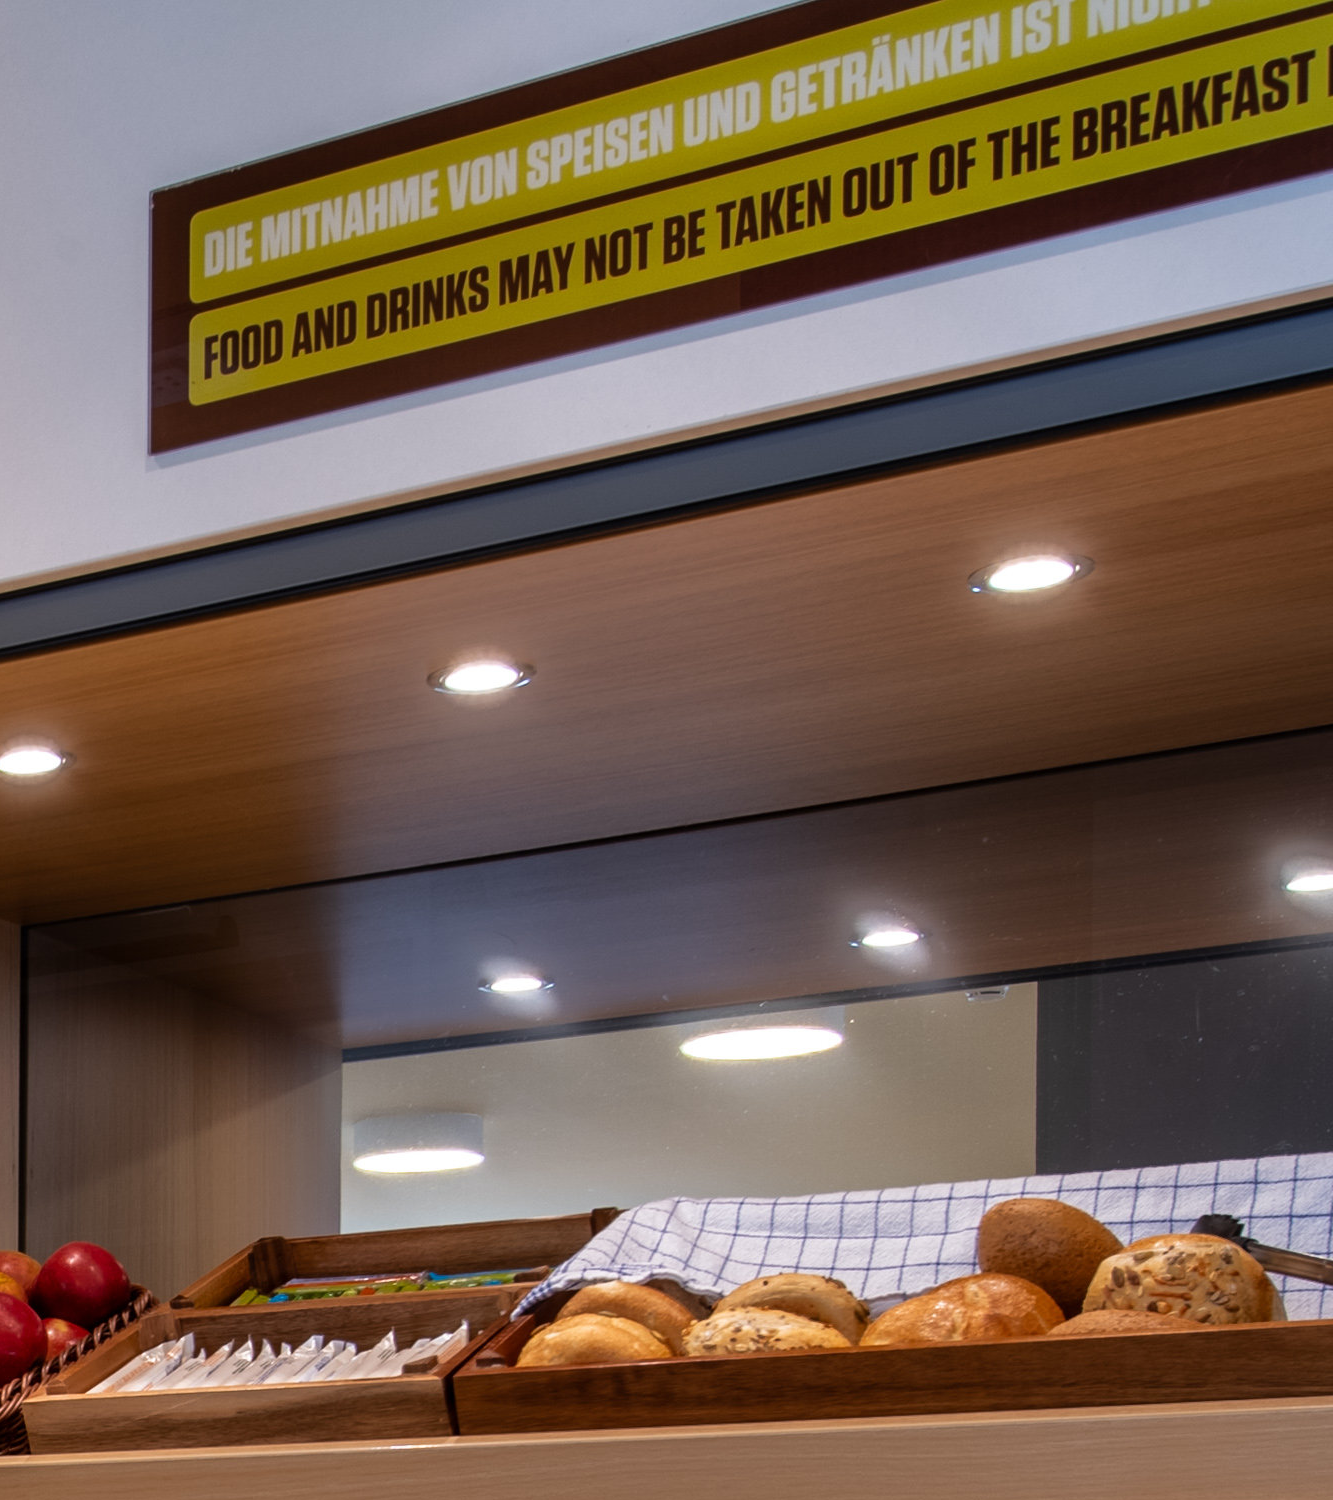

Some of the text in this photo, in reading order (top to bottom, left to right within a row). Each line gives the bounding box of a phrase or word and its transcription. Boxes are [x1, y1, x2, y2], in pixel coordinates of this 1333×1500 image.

[204, 221, 253, 278] DIE
[260, 170, 439, 262] MITNAHME
[446, 147, 518, 212] VON
[526, 103, 674, 190] SPEISEN
[683, 80, 761, 147] UND
[770, 13, 1001, 123] GETRÄNKEN
[1010, 0, 1075, 59] IST
[204, 318, 284, 380] FOOD
[291, 300, 357, 358] AND
[366, 265, 490, 339] DRINKS
[498, 241, 575, 306] MAY
[584, 222, 653, 284] NOT
[663, 208, 706, 265] BE
[716, 174, 831, 251] TAKEN
[842, 153, 919, 218] OUT
[929, 137, 976, 196] OF
[987, 115, 1061, 181] THE
[1072, 49, 1316, 161] BREAKFAST
